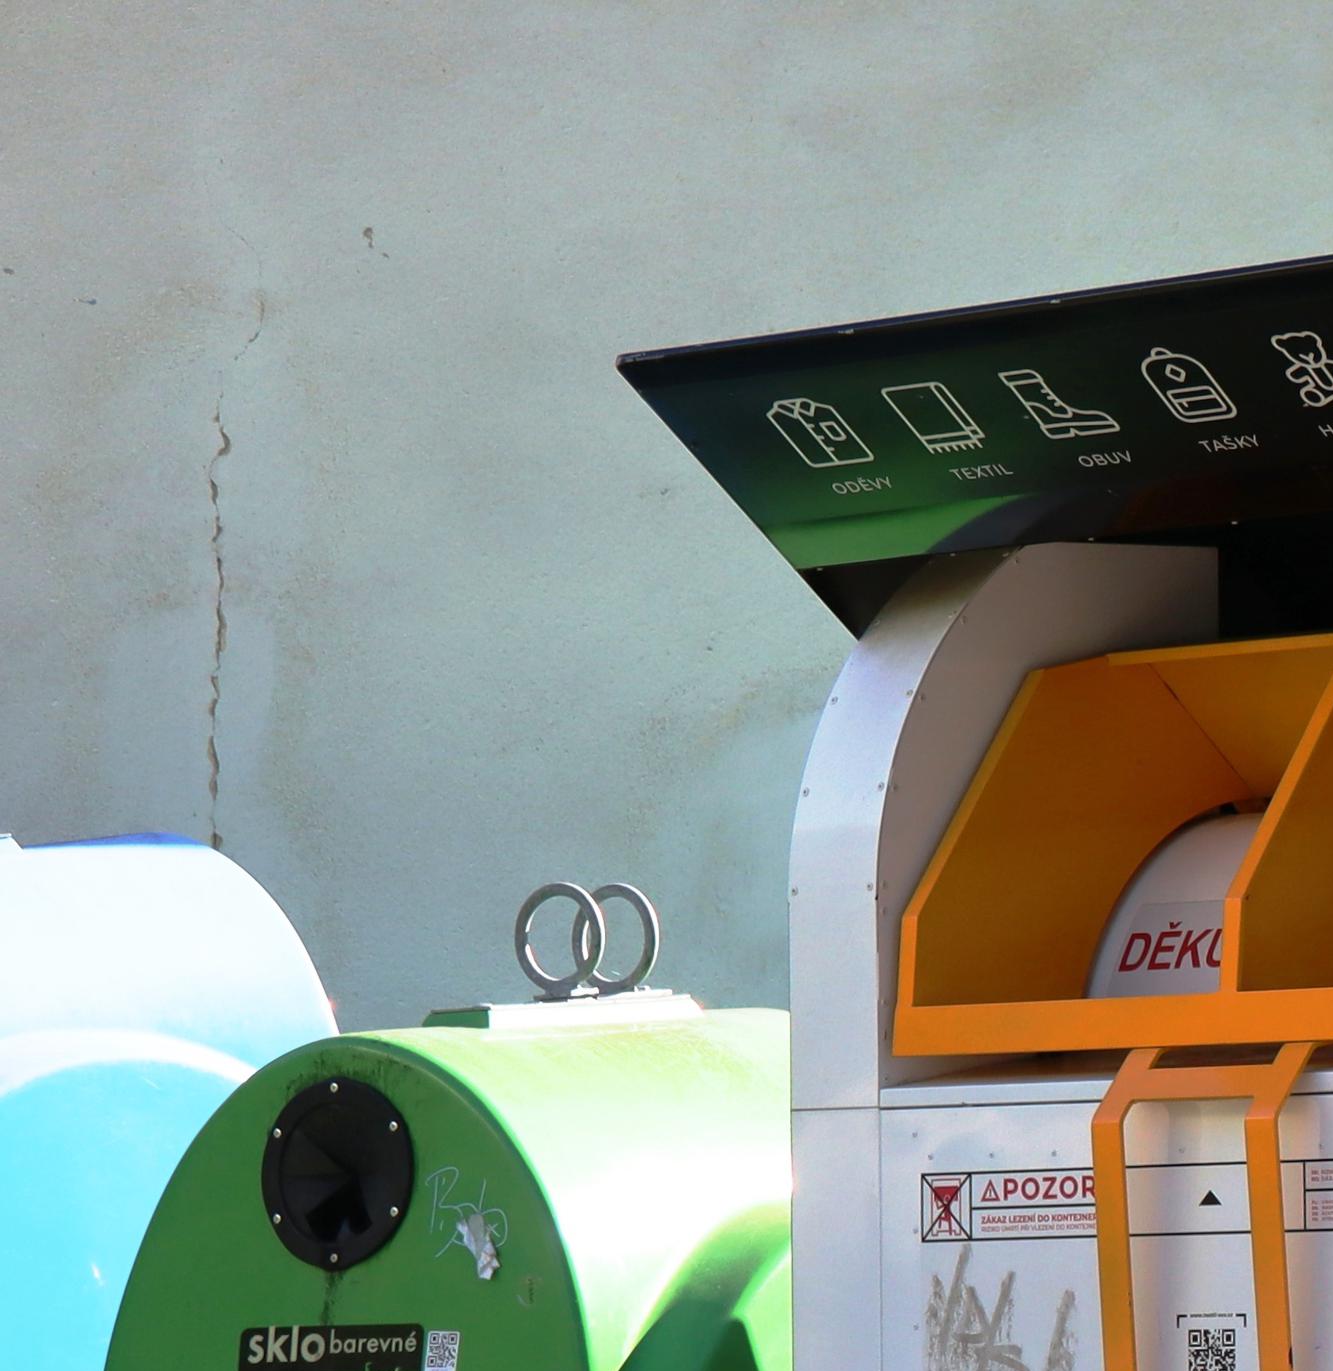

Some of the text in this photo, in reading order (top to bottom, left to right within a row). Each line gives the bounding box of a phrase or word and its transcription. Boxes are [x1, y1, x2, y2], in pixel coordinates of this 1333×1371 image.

[1198, 434, 1259, 453] TAŠKY
[1078, 450, 1132, 468] OBUV
[949, 463, 1014, 481] TEXTIL
[831, 476, 893, 496] ODĚVY
[981, 1214, 1007, 1225] ZÁKAZ
[1008, 1212, 1036, 1224] LEZENÍ
[1037, 1213, 1050, 1223] DO
[247, 1325, 418, 1365] sklo barevné
